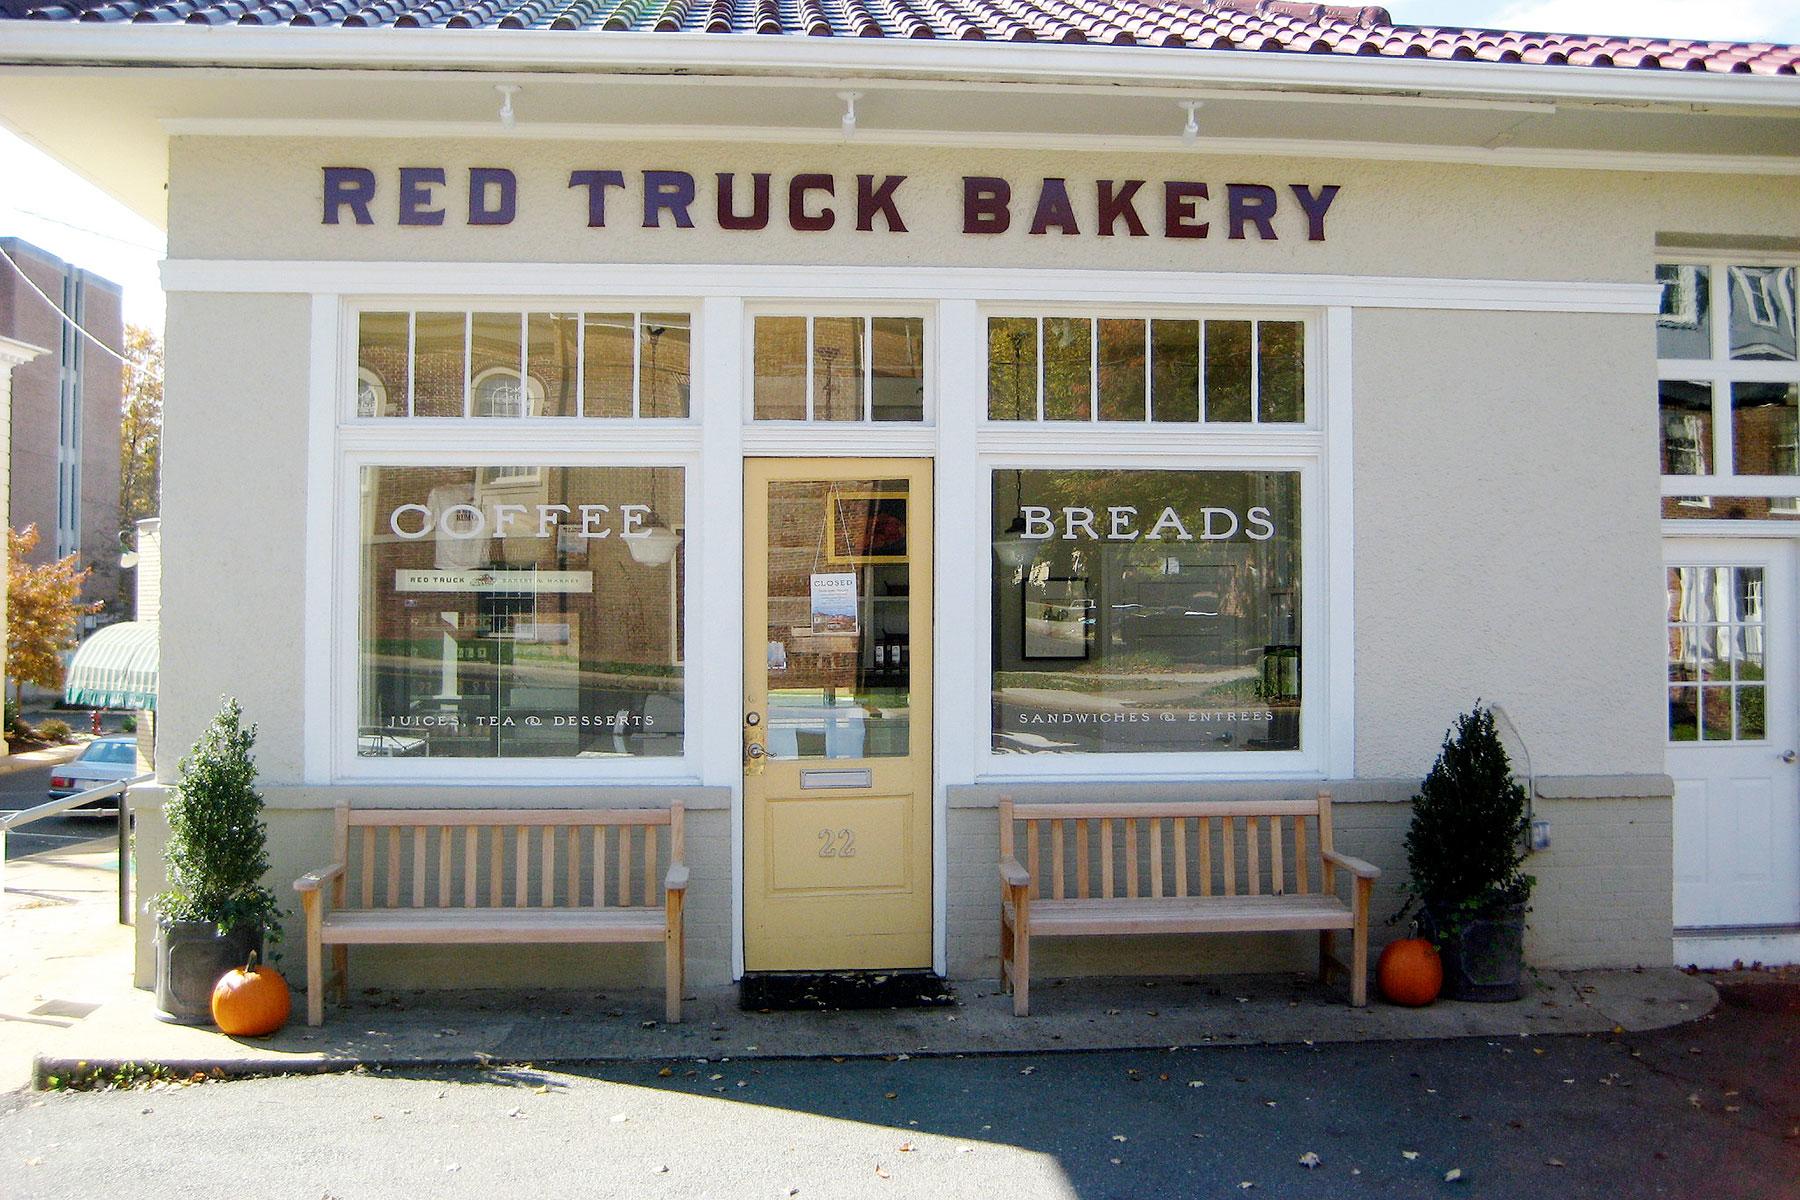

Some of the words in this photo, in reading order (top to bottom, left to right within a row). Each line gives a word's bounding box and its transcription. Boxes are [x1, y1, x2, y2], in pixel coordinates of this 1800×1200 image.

[320, 166, 517, 226] RED
[568, 169, 910, 232] TRUCK
[961, 176, 1342, 241] BAKERY
[389, 503, 654, 540] COFFEE
[1019, 506, 1276, 541] BREADS
[387, 715, 467, 728] JUICES,
[476, 715, 516, 726] TEA
[553, 715, 655, 726] DESSERTS
[1019, 712, 1151, 724] SANDWICHES
[1188, 711, 1274, 722] ENTREES
[817, 828, 856, 858] 22
